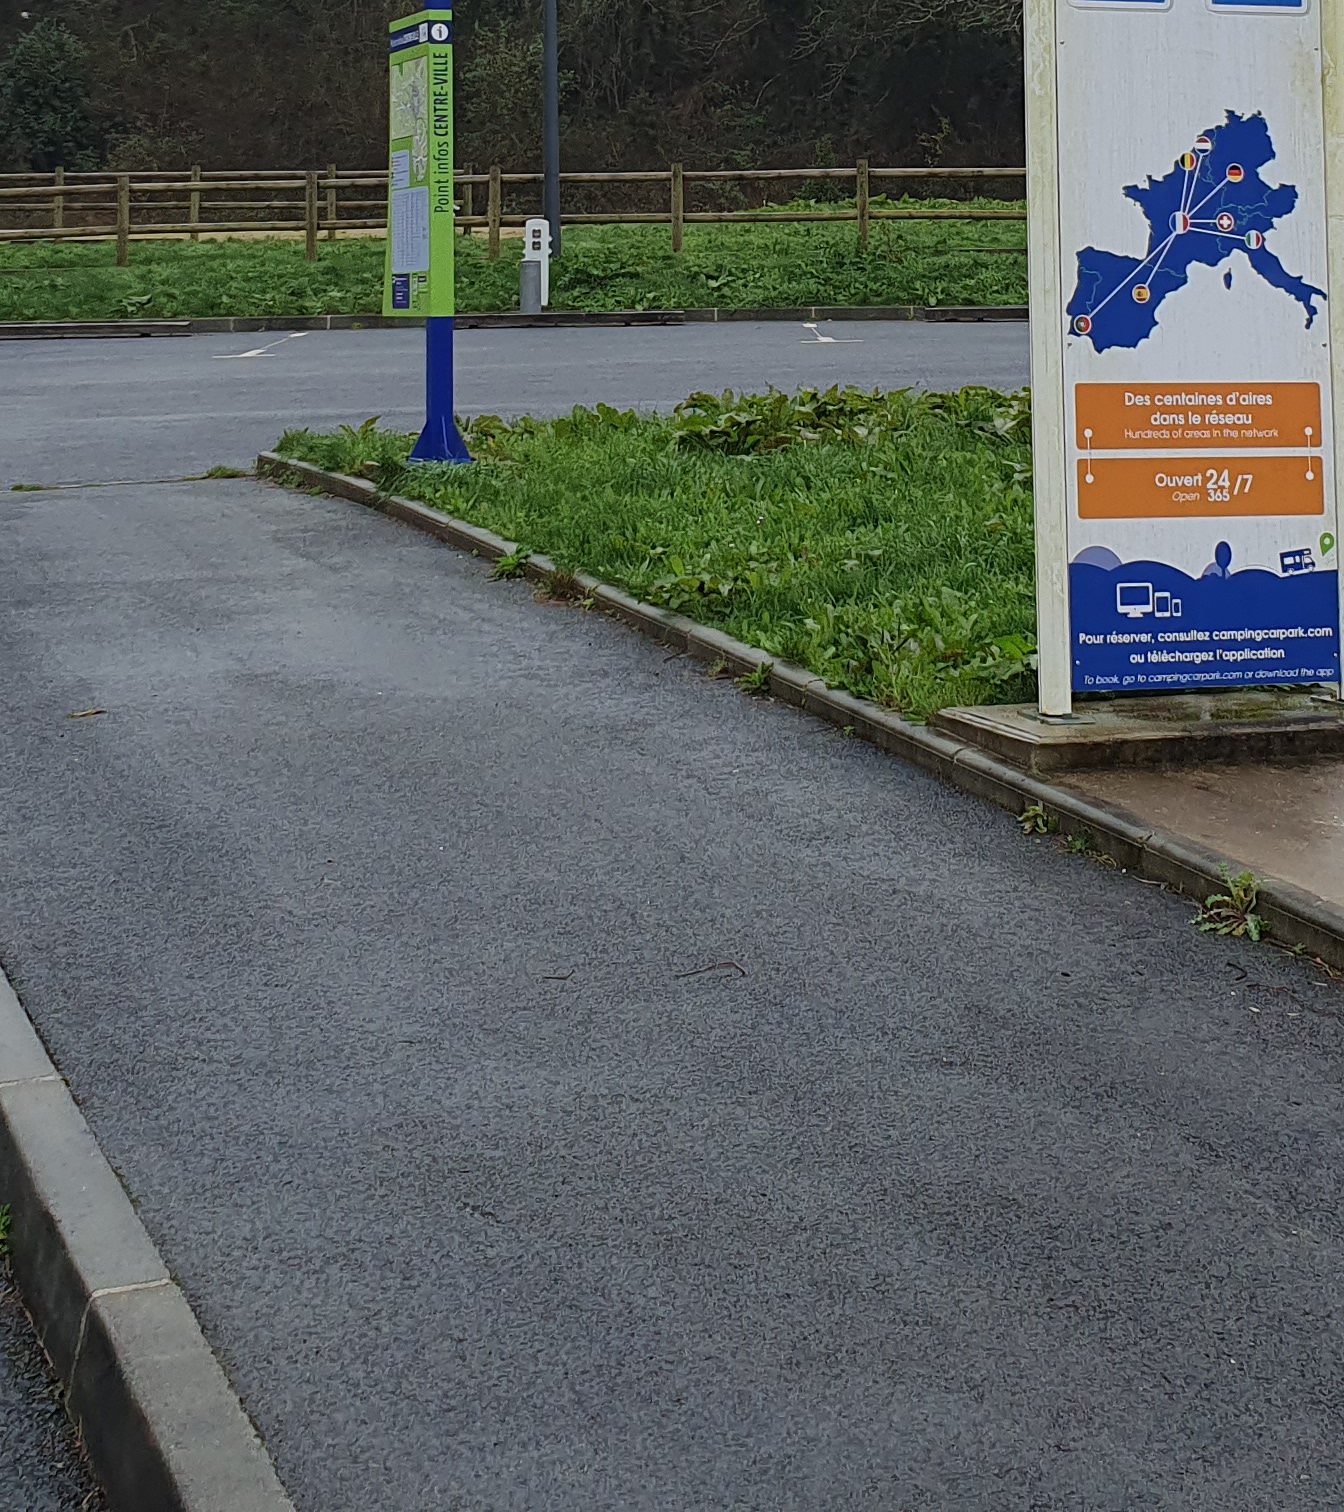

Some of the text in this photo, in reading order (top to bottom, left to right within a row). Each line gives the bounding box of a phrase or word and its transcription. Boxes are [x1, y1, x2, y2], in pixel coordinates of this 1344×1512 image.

[433, 52, 450, 213] Point infos CENTRE-VILLE
[1124, 391, 1273, 406] Des centaines d'aires
[1150, 409, 1252, 425] dans le réseau
[1124, 428, 1278, 439] Hundreds of areas in the network
[1155, 472, 1203, 487] Ouvert
[1205, 468, 1231, 489] 24
[1172, 489, 1230, 503] Open 365
[1078, 626, 1333, 645] Pour réserver, consultez campingcarpark.com
[1129, 647, 1285, 664] ou téléchargez l'application
[1084, 674, 1094, 685] To
[1122, 675, 1135, 686] go
[1137, 674, 1146, 683] to
[1148, 671, 1243, 684] campingcarpark.com
[1244, 671, 1253, 679] or
[1255, 668, 1299, 679] download
[1300, 667, 1314, 677] the
[1316, 668, 1335, 678] app
